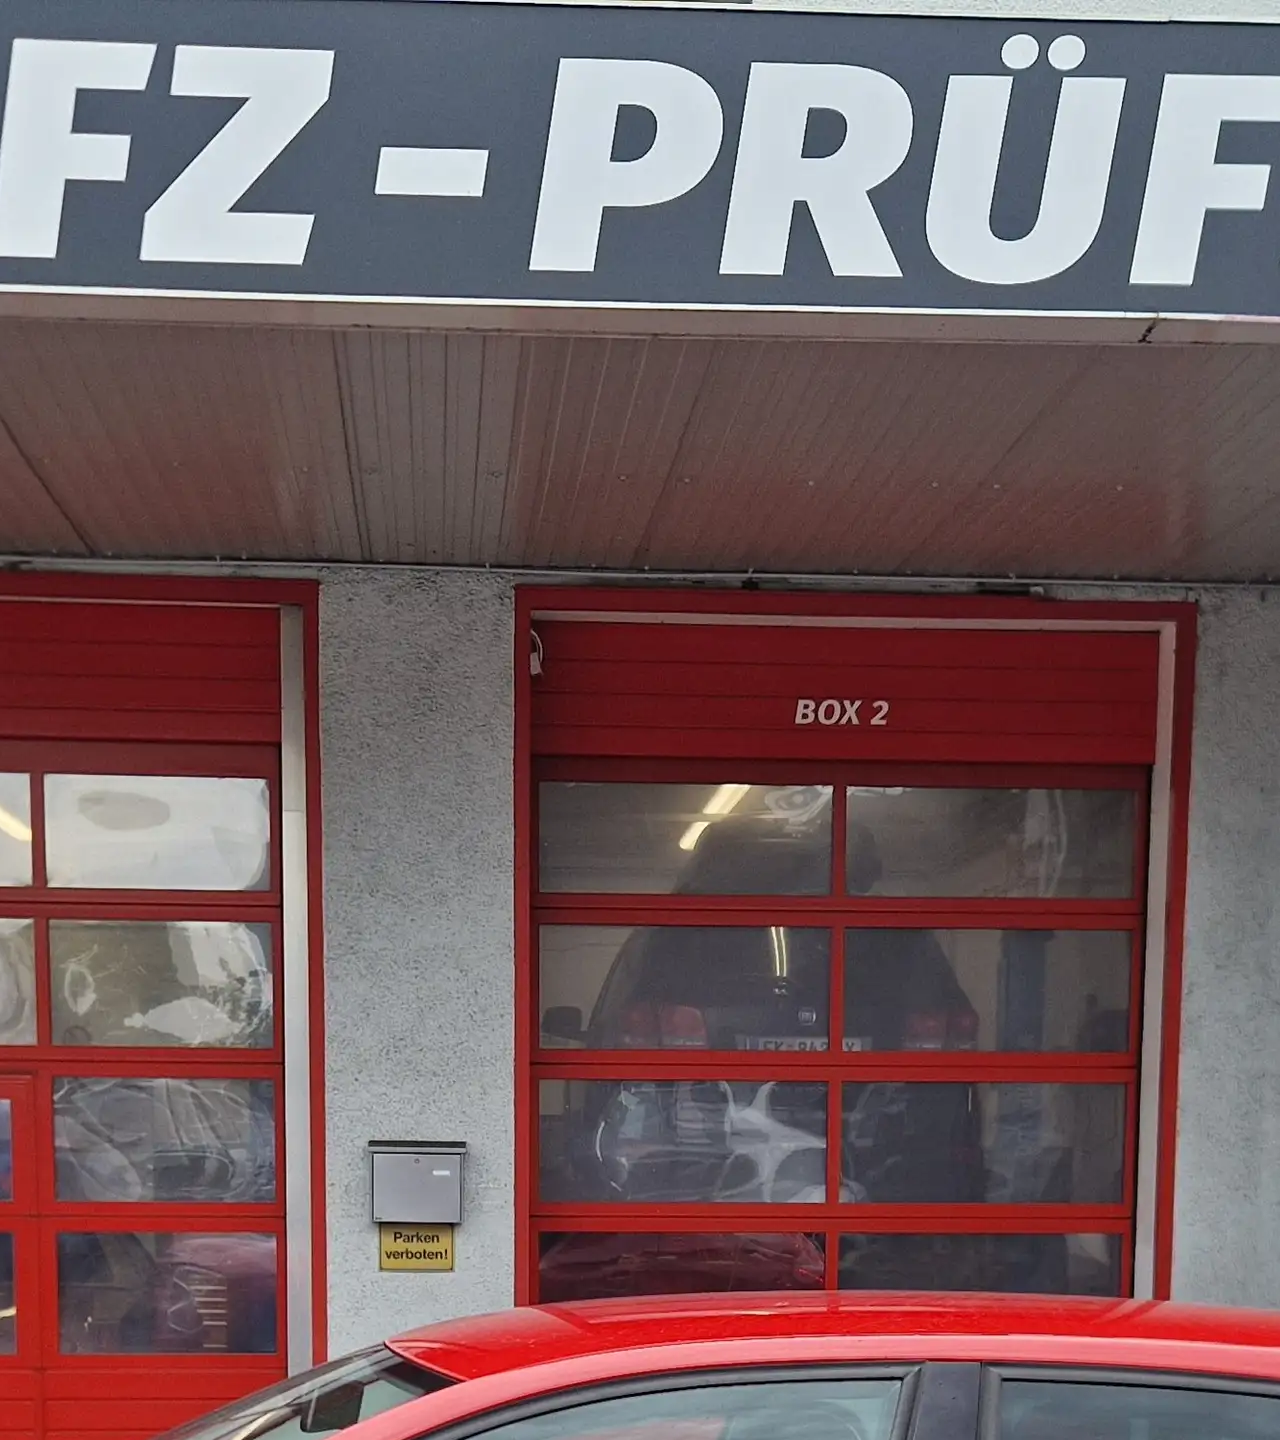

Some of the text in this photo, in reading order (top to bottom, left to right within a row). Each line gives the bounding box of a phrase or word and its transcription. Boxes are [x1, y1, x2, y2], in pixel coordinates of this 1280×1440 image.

[795, 699, 890, 725] BOX 2
[393, 1231, 440, 1244] Parken
[385, 1248, 448, 1260] verboten!
